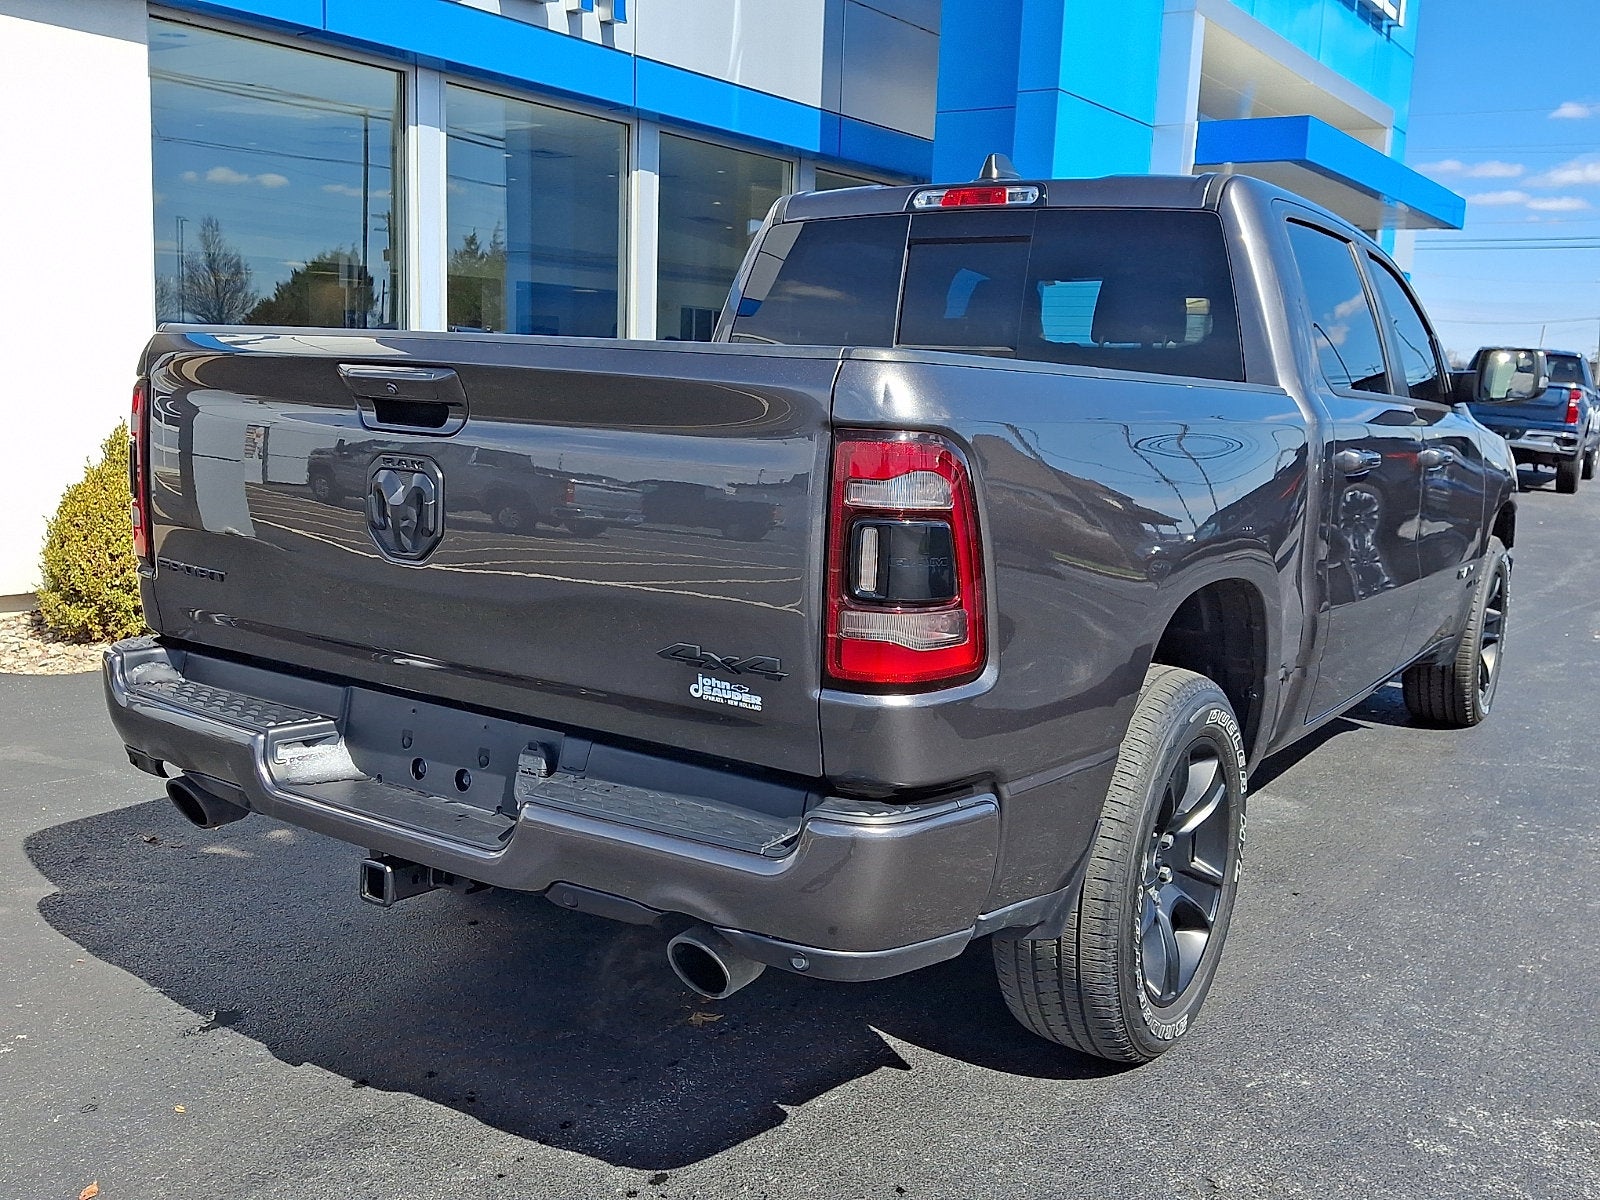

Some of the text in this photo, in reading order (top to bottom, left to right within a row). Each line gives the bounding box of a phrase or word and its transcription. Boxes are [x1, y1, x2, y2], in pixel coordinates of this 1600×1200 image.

[382, 457, 425, 470] RAM
[703, 685, 762, 705] SAUDER
[1205, 708, 1248, 795] DUELER
